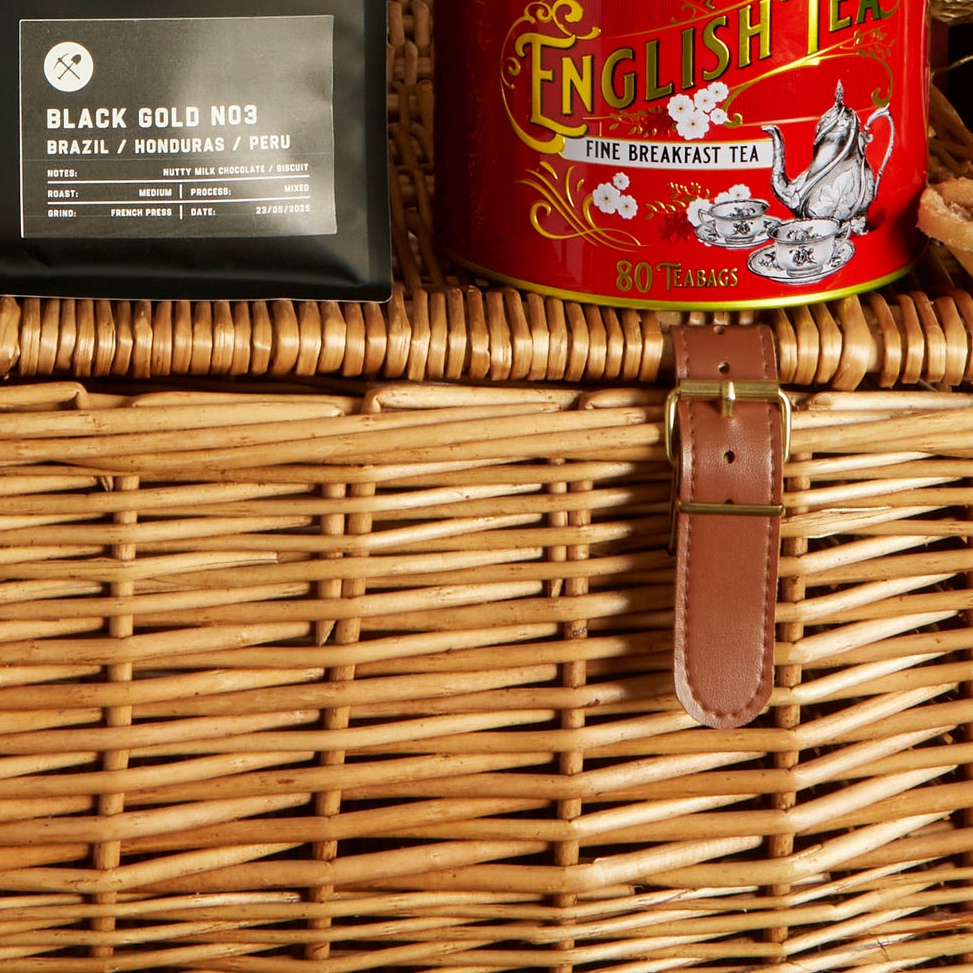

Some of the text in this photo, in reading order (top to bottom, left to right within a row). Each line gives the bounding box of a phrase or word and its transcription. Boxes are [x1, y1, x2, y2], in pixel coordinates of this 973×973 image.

[46, 108, 127, 129] BLACK
[138, 106, 199, 128] GOLD
[47, 134, 291, 155] BRAZIL / HONDURAS / PERU
[586, 140, 759, 164] FINE BREAKFAST TEA
[47, 169, 78, 178] NOTES:
[163, 168, 191, 177] NUTTY
[194, 167, 215, 176] MILK
[218, 165, 265, 175] CHOCOLATE
[276, 163, 309, 172] BISCUIT
[47, 188, 172, 198] ROAST: MEDIUM
[190, 184, 309, 196] PROCESS: MIXED
[47, 208, 172, 218] GRIND: FRENCH PRESS
[190, 204, 310, 216] DATE: 23/05/2025
[615, 260, 739, 293] 80 TEABAGS
